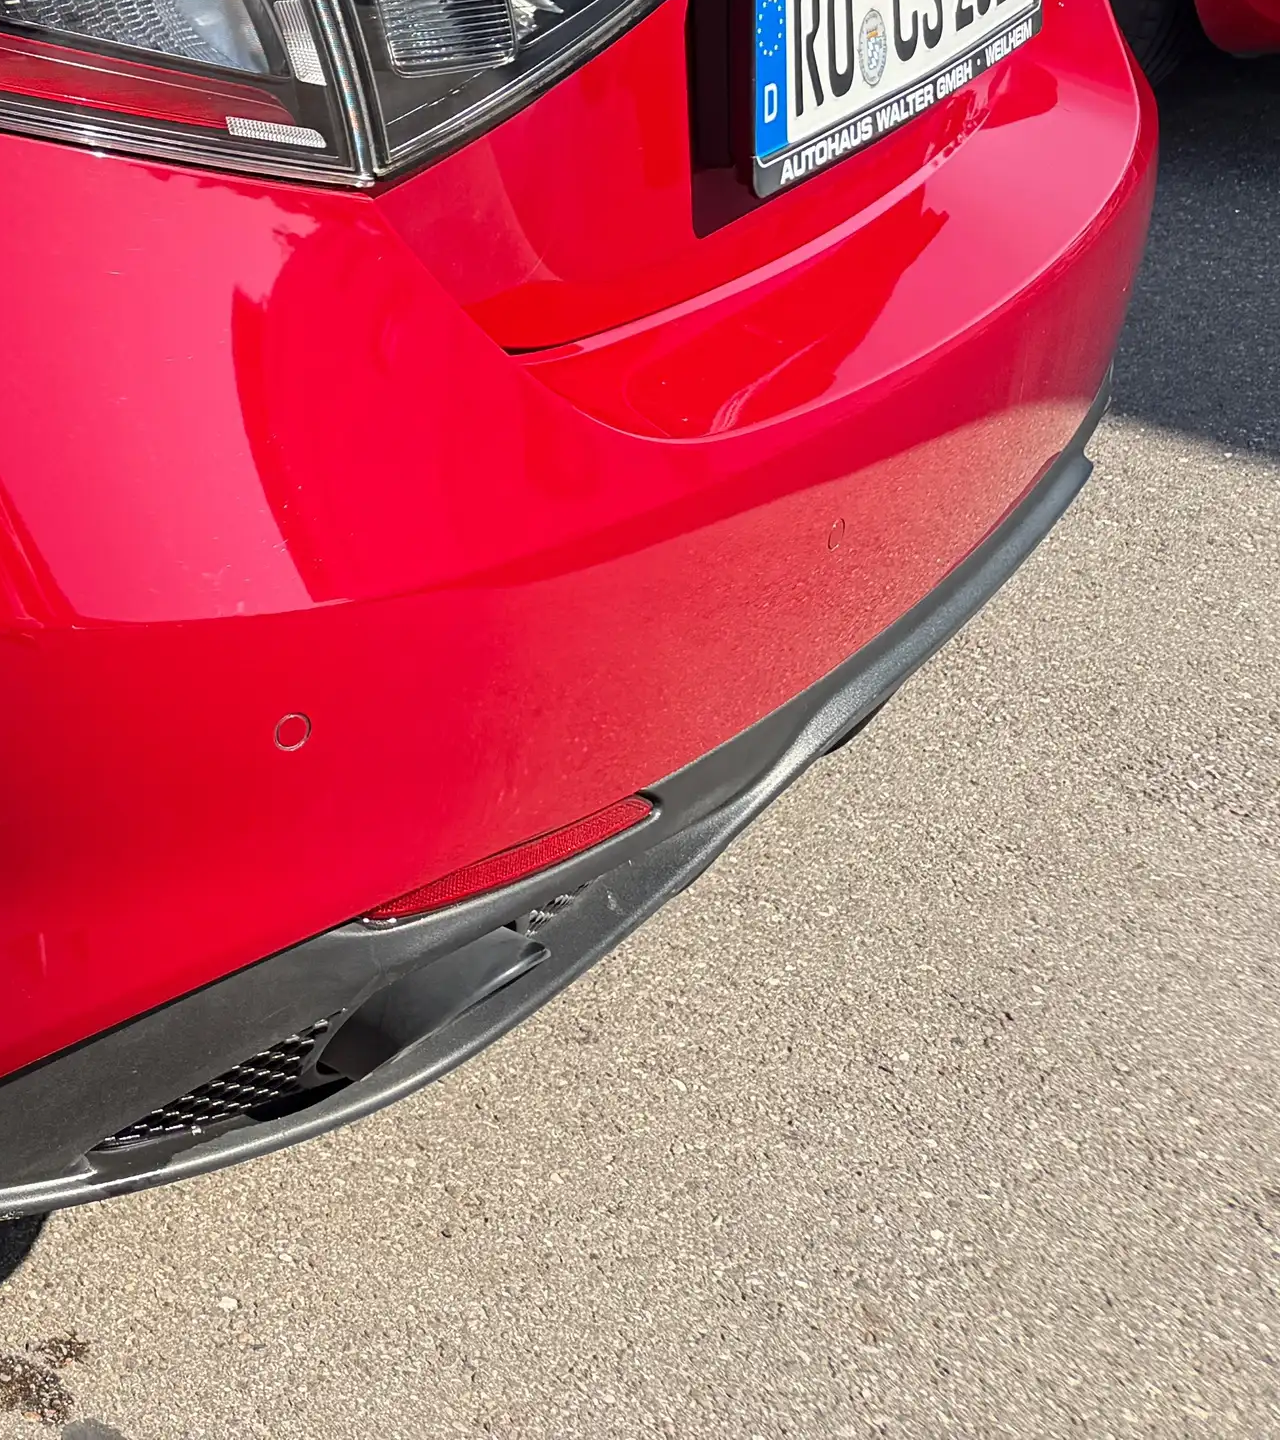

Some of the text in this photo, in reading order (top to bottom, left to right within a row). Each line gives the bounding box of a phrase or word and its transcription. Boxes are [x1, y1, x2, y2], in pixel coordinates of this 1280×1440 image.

[764, 83, 778, 124] D
[780, 18, 1033, 185] AUTOHAUS WALTER GMBH WEILHEIM
